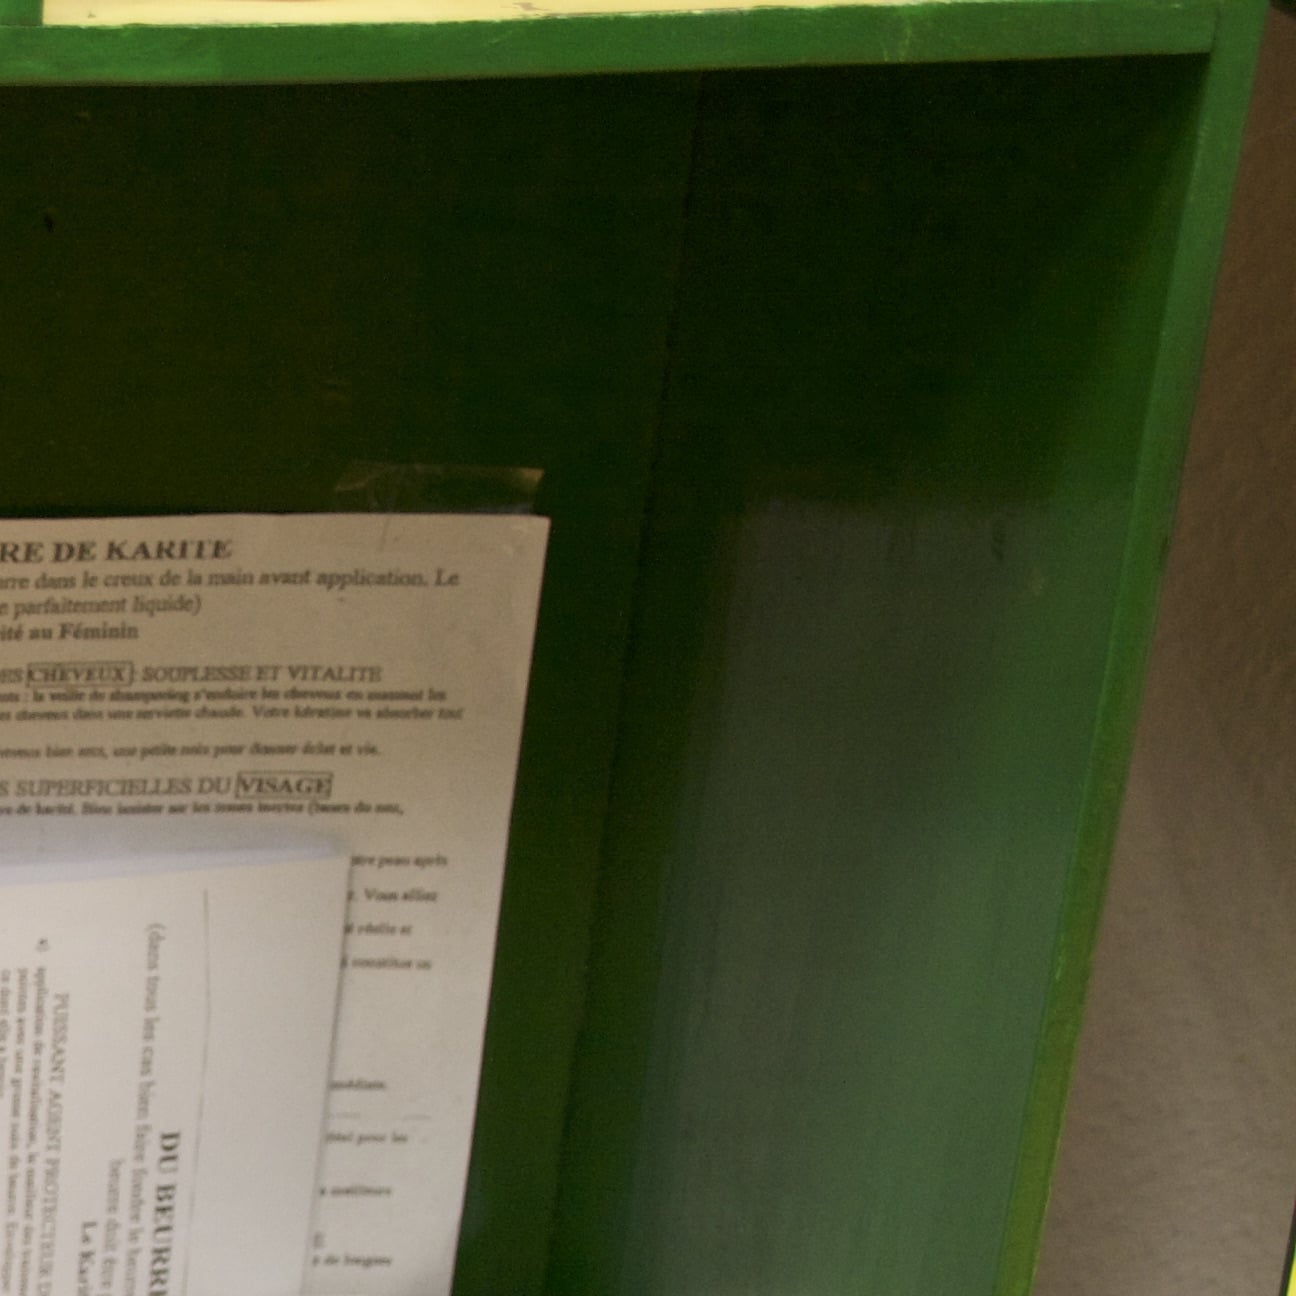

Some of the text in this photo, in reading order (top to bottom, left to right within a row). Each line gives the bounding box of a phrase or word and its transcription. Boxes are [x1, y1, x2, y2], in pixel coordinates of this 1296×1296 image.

[51, 541, 97, 563] DE
[105, 539, 233, 561] KARITE
[27, 628, 54, 640] au
[57, 621, 140, 641] Féminin
[29, 667, 124, 684] CHEVEUX
[14, 777, 193, 798] SUPERFICIELLES
[198, 779, 233, 797] DU
[239, 777, 330, 795] VISAGE
[159, 1131, 180, 1173] DU
